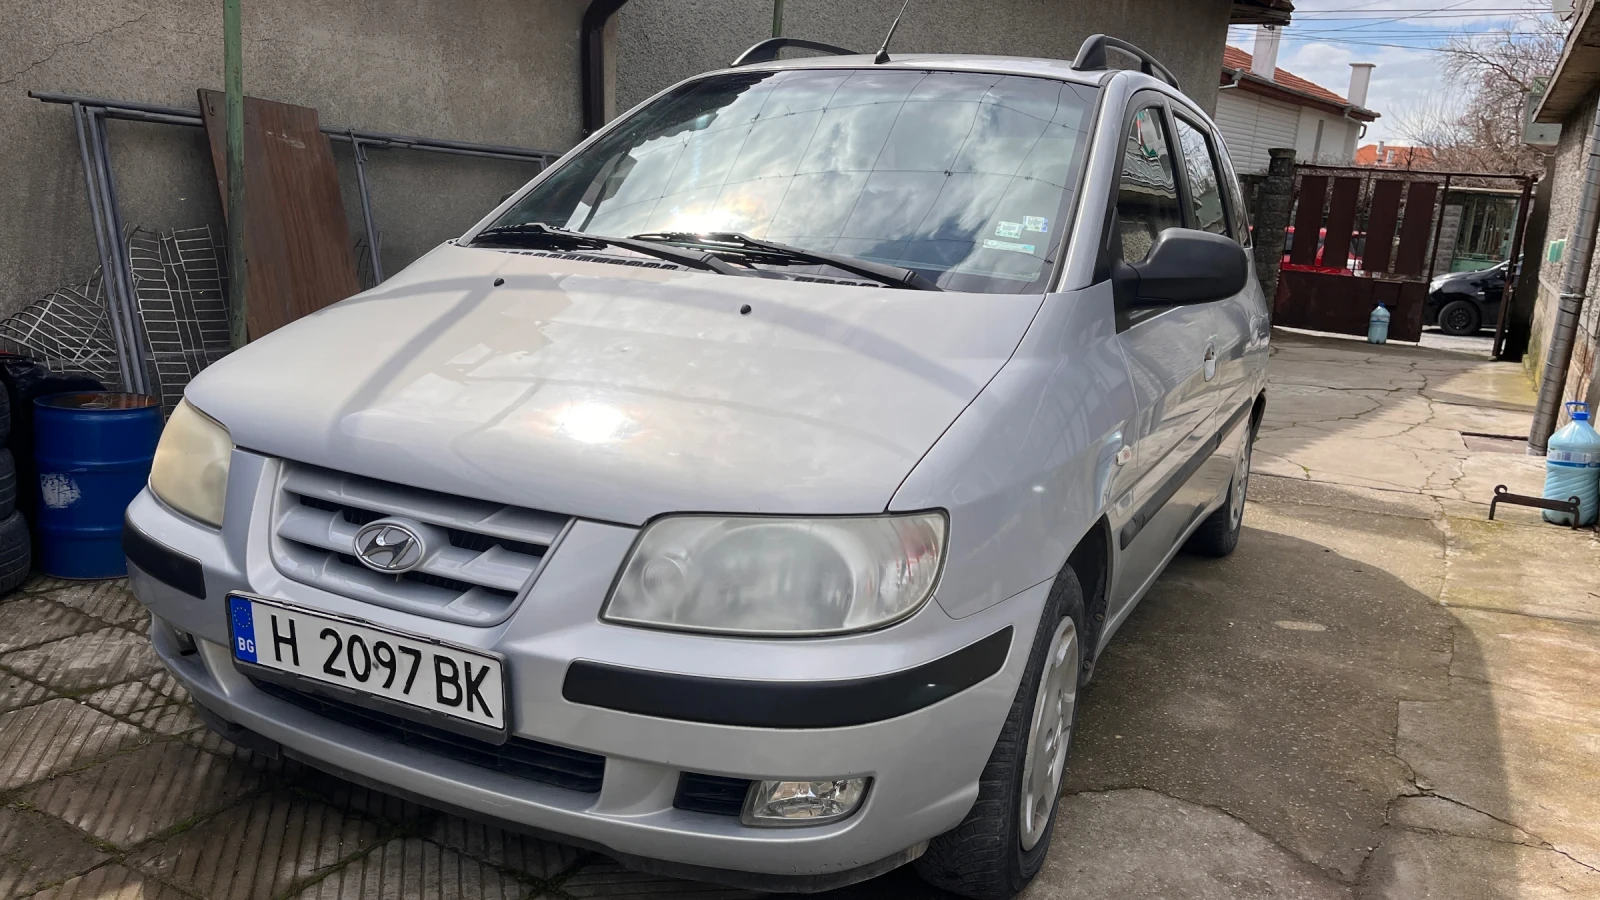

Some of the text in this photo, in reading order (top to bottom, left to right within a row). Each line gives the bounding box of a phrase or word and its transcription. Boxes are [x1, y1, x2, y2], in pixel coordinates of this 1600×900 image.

[237, 636, 255, 654] BG
[271, 614, 494, 718] H 2097 BK
